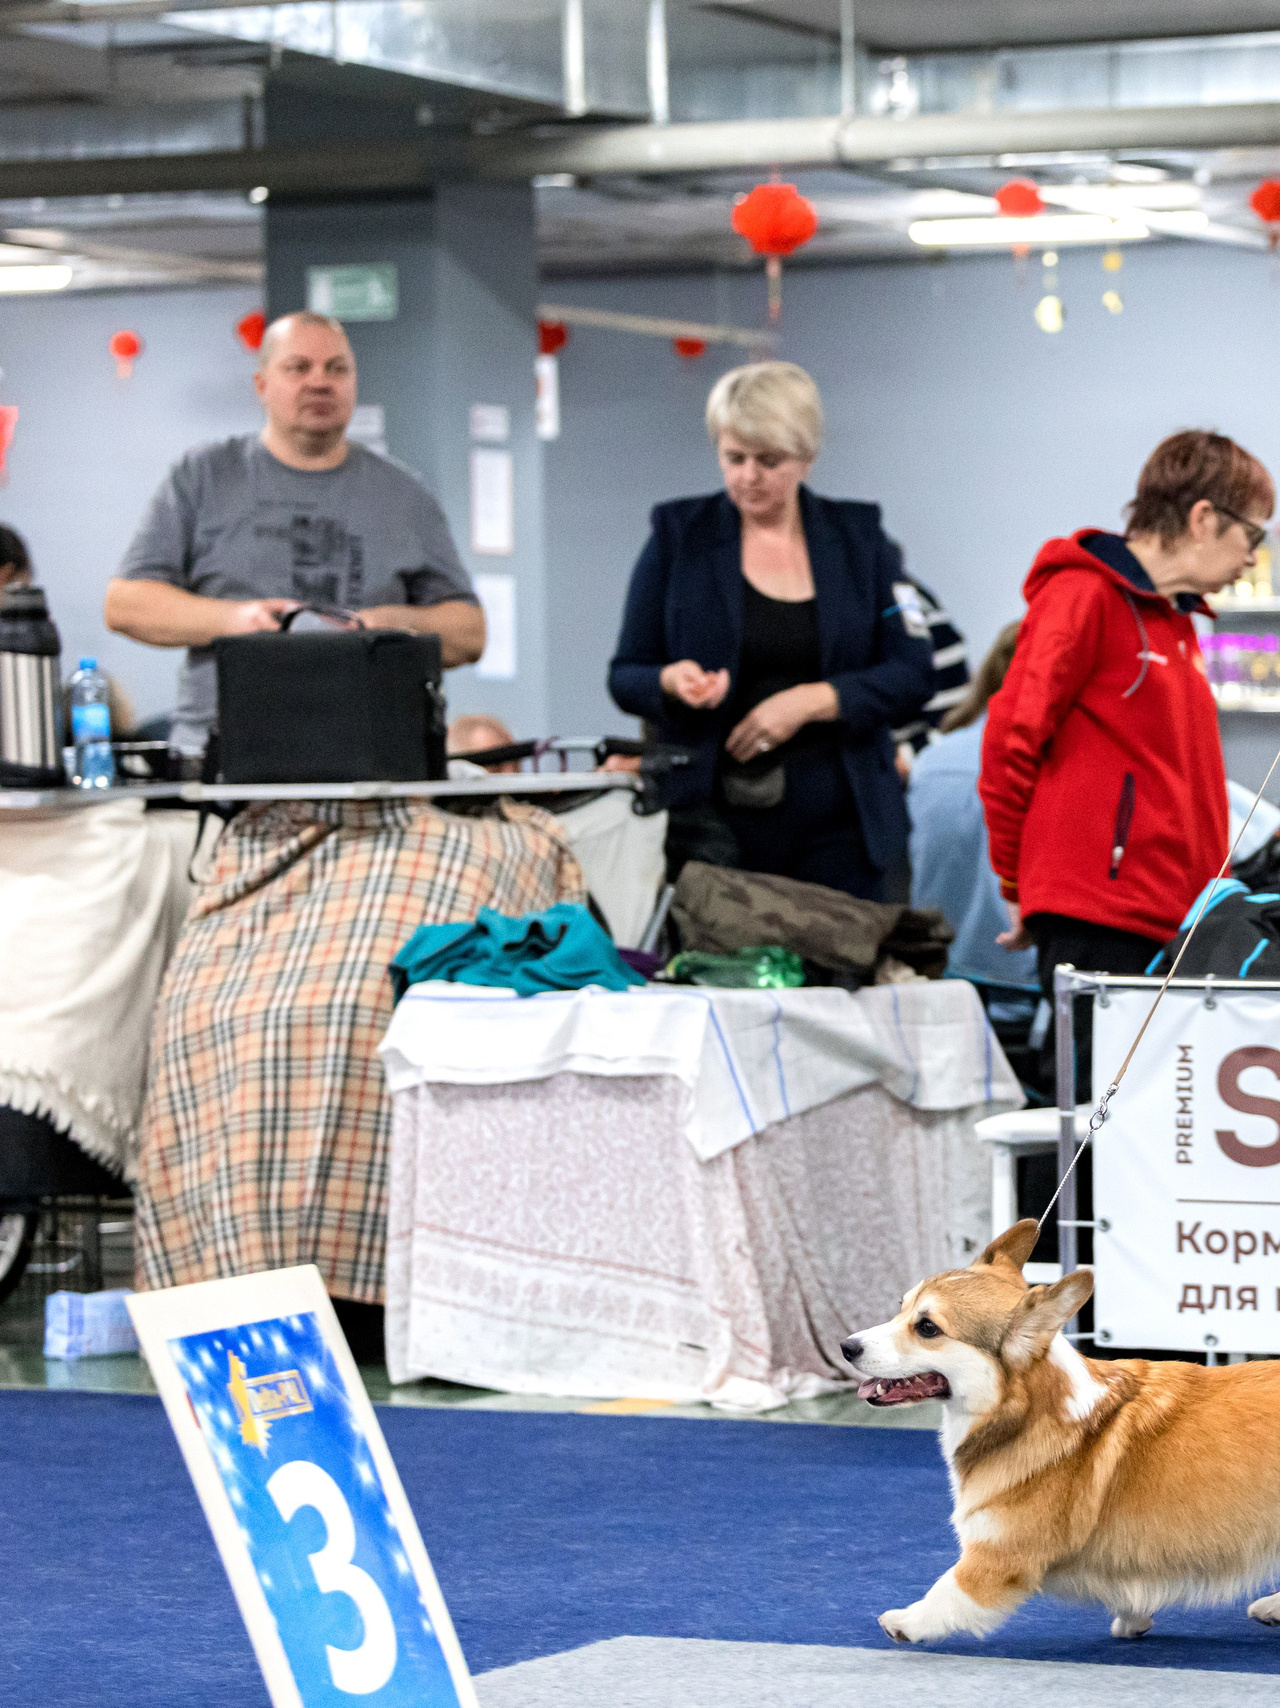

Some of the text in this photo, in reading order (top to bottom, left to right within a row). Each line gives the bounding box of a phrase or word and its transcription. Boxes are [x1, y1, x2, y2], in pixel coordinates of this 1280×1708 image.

[1176, 1045, 1193, 1164] PREMIUM
[1178, 1283, 1258, 1314] для
[266, 1460, 397, 1695] 3
